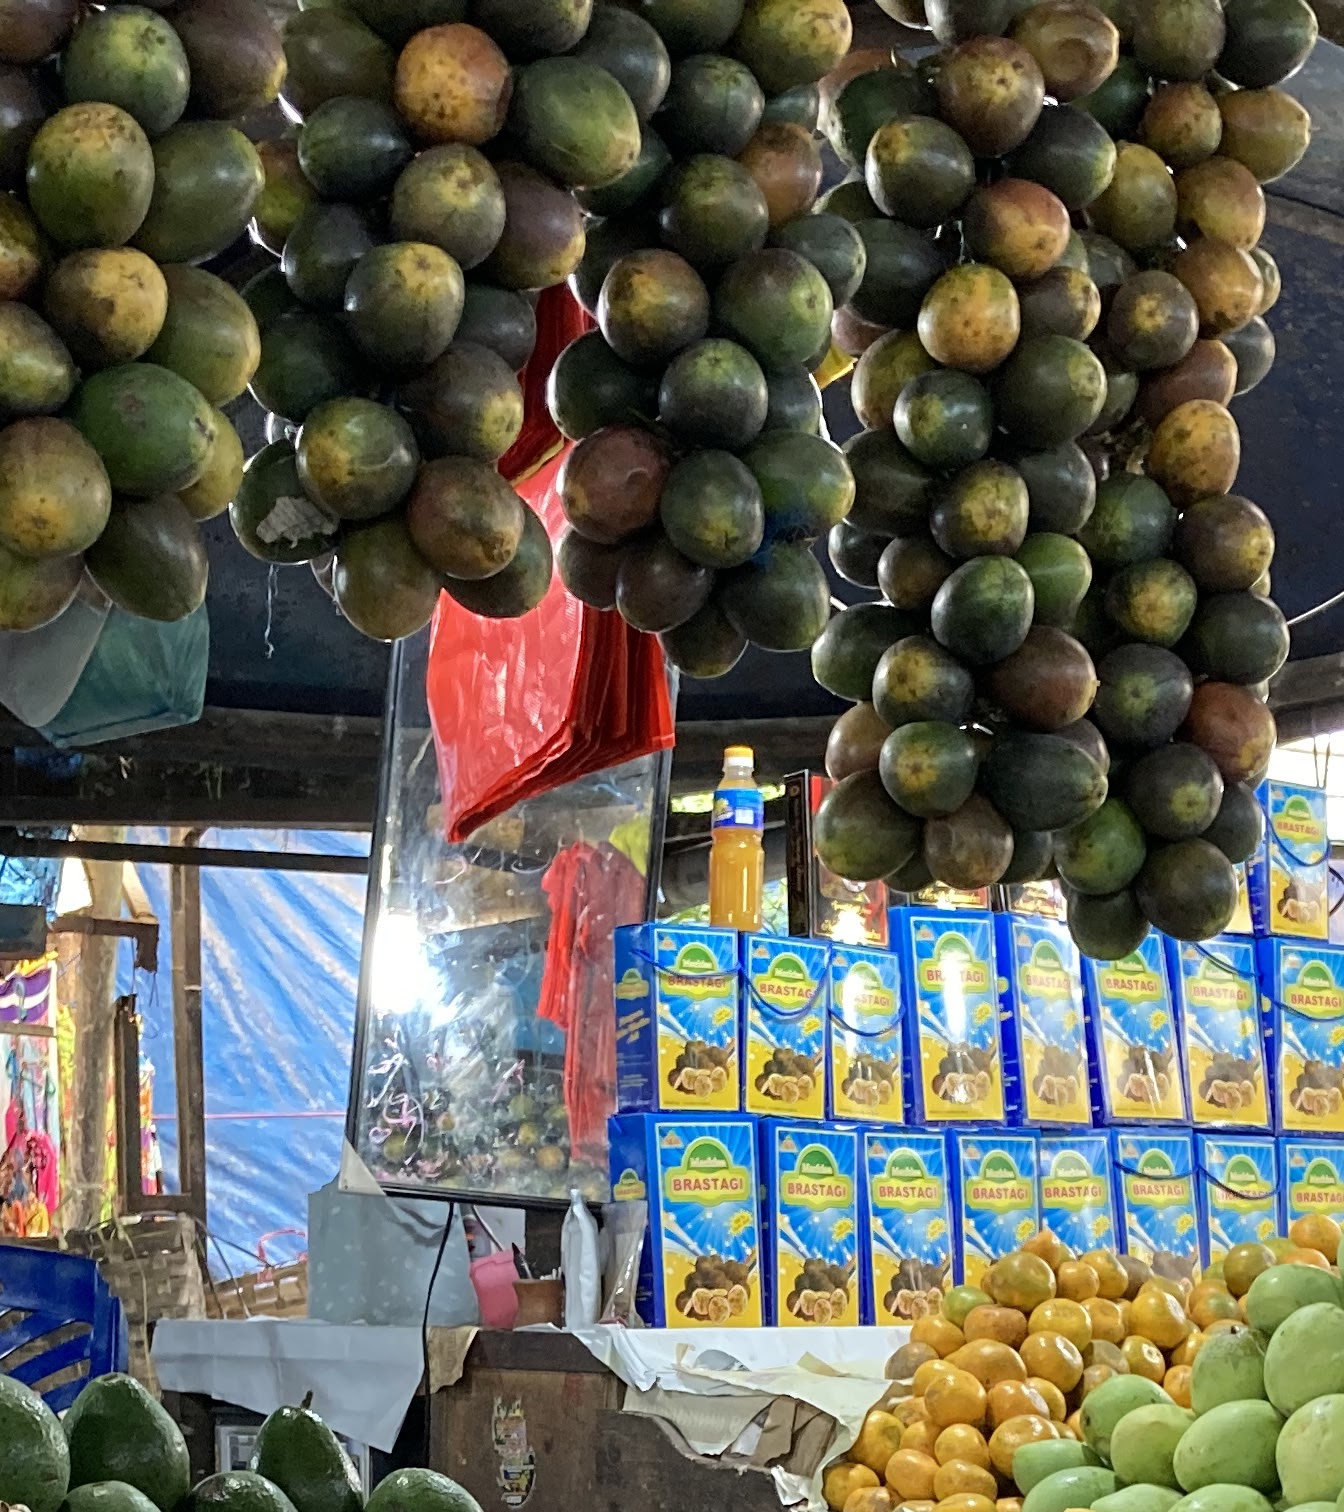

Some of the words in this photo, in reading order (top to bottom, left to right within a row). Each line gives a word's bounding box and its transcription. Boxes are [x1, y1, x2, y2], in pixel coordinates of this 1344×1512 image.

[926, 969, 985, 983] BRTAGI
[759, 983, 814, 999] BRASTAG
[1105, 978, 1158, 992] BRASTAGI
[1193, 986, 1247, 1000] BRASTAGI
[1290, 993, 1343, 1008] BRASTAGI
[672, 1177, 744, 1192] BRASTAGI
[787, 1182, 847, 1198] BRASTAGI
[1132, 1183, 1185, 1197] BRASTAGI
[878, 1185, 937, 1199] BRASTAGI
[972, 1187, 1029, 1201] BRASTAGI
[1044, 1185, 1102, 1199] BRASTAGI
